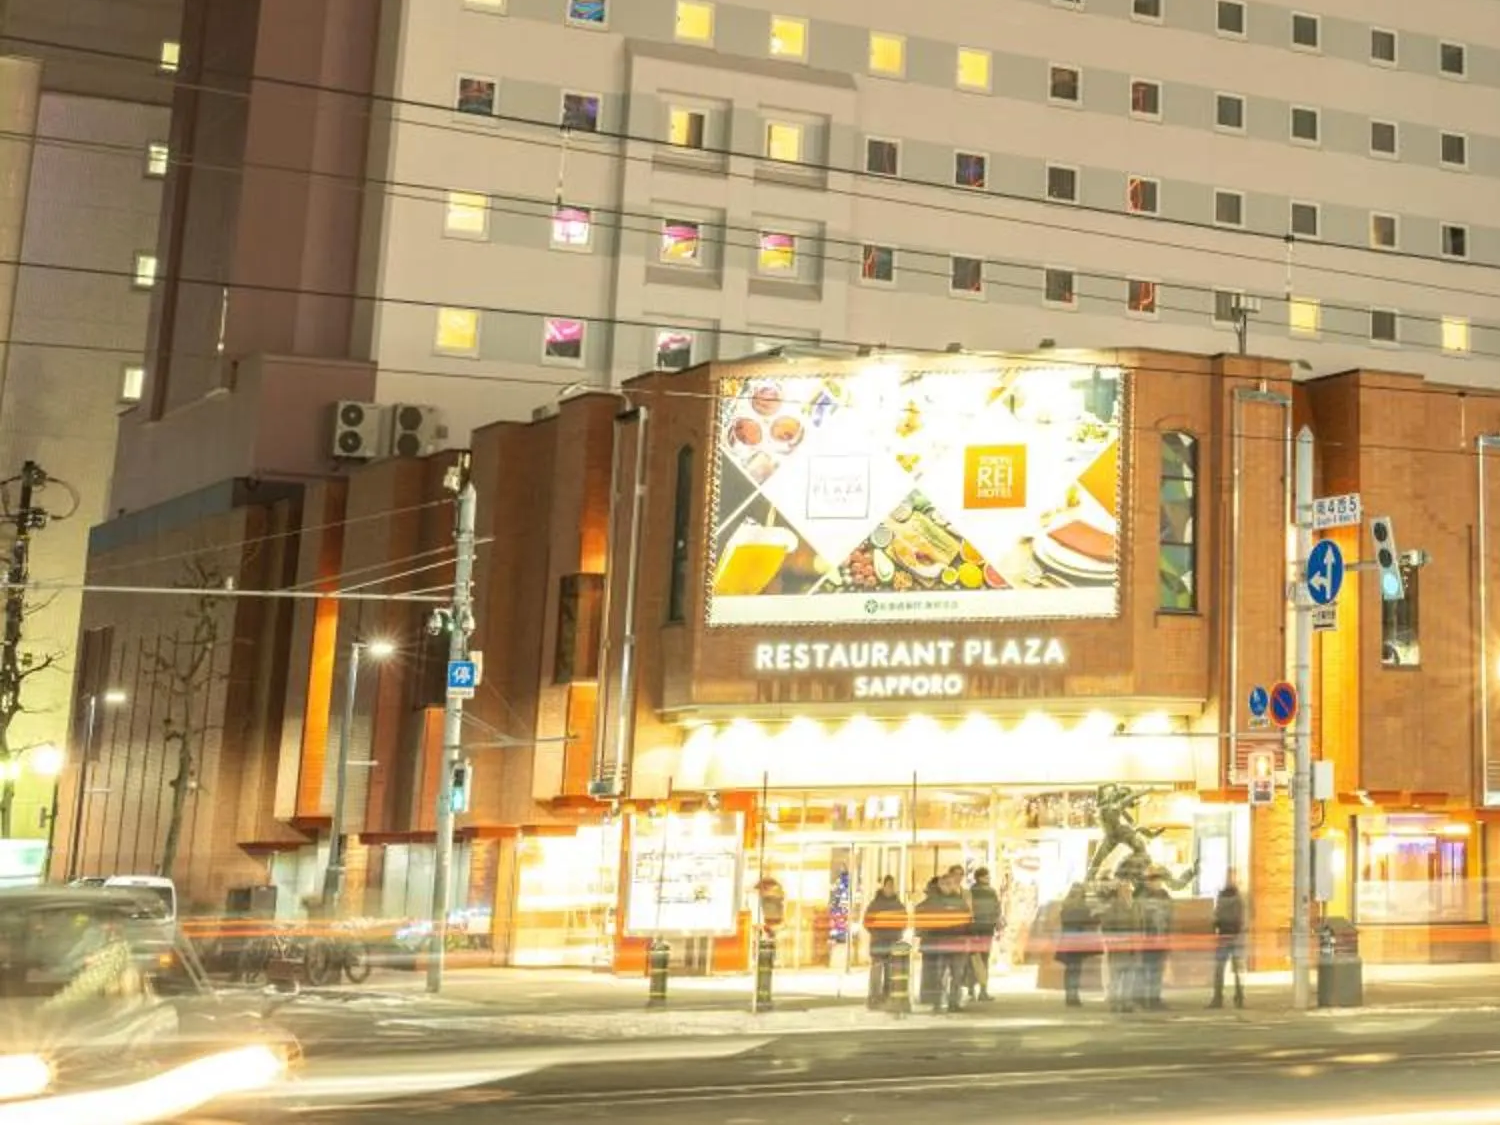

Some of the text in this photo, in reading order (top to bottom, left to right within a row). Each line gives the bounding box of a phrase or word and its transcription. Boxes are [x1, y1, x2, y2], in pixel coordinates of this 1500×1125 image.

[978, 466, 1012, 488] REI
[756, 639, 1065, 669] RESTAURANT PLAZA
[854, 674, 963, 697] SAPPORO
